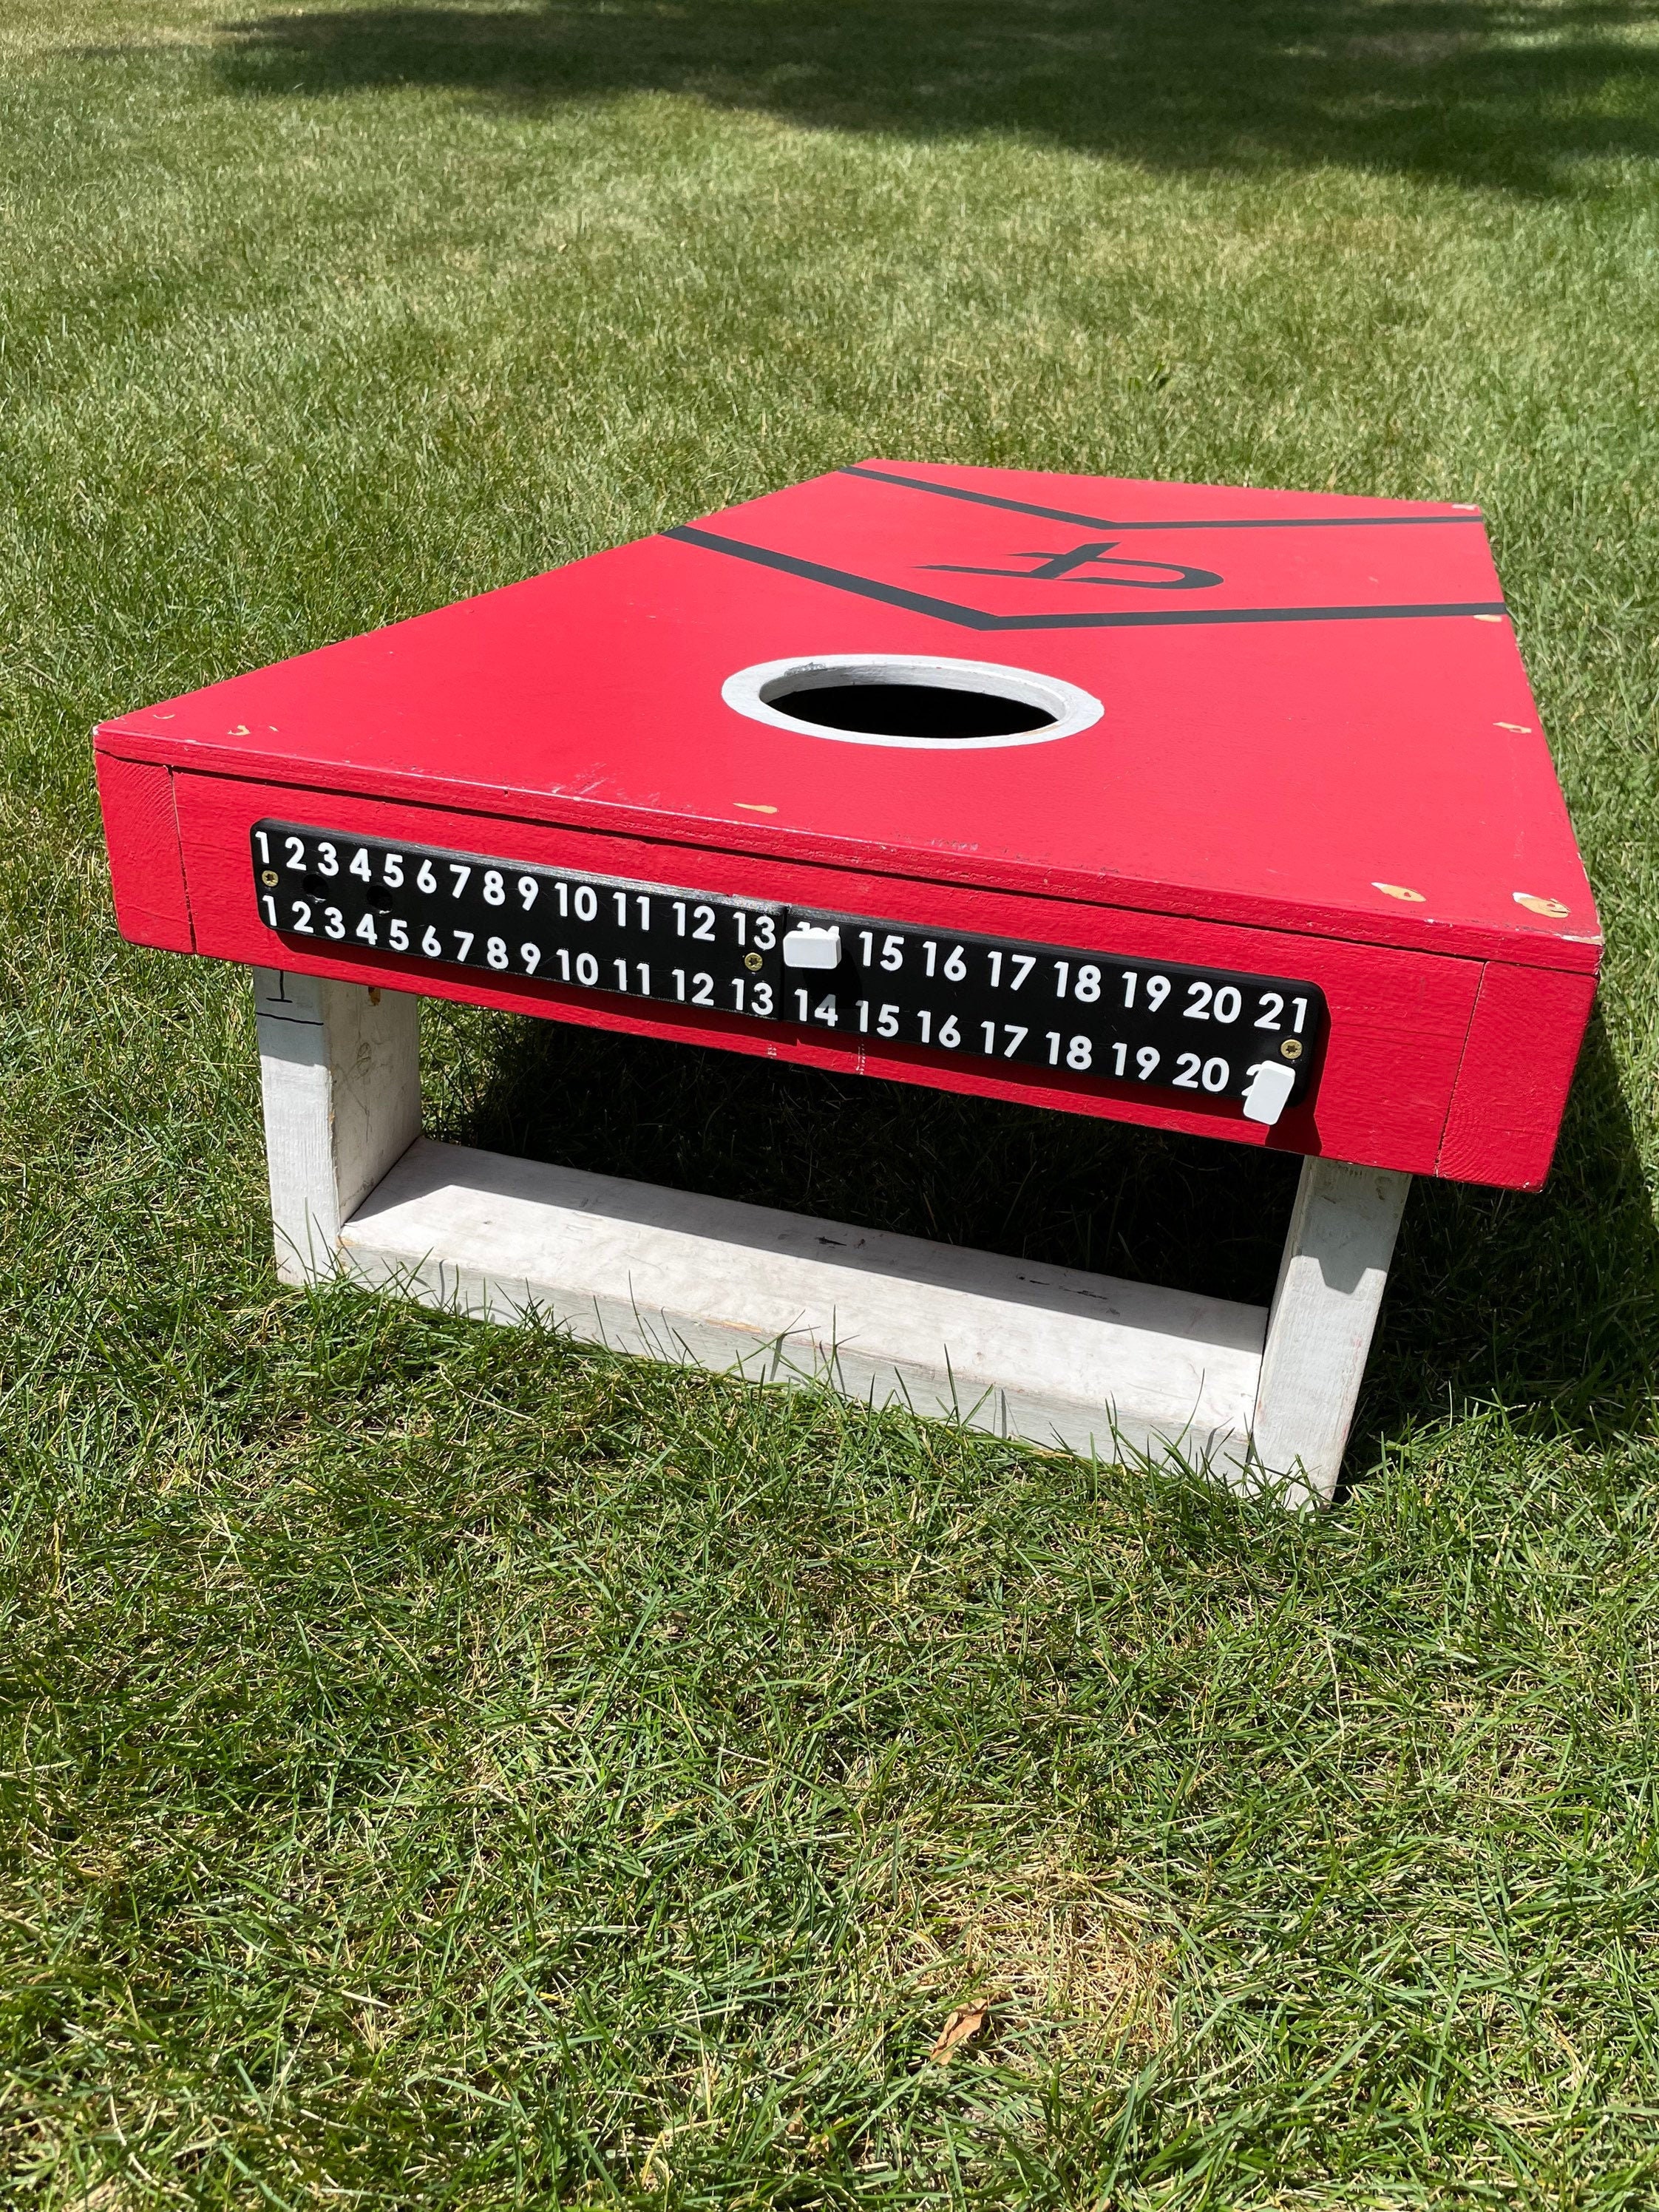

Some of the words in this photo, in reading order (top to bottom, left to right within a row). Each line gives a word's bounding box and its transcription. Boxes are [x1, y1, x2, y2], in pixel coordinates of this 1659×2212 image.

[254, 830, 270, 864] 1
[285, 836, 307, 871] 2
[317, 841, 339, 877] 3
[349, 847, 372, 883] 4
[382, 852, 404, 888] 5
[416, 859, 437, 894] 6
[449, 864, 472, 899] 7
[483, 870, 506, 906] 8
[518, 875, 539, 912] 9
[554, 882, 597, 922] 10
[612, 892, 650, 931] 11
[672, 901, 716, 942] 12
[733, 912, 776, 951] 13
[858, 931, 905, 971] 15
[922, 940, 967, 982] 16
[987, 951, 1037, 991] 17
[1054, 961, 1102, 1002] 18
[1122, 971, 1171, 1013] 19
[1182, 981, 1242, 1024] 20
[1253, 992, 1308, 1034] 21
[262, 895, 277, 926] 1
[291, 900, 314, 934] 2
[324, 906, 346, 939] 3
[356, 913, 378, 946] 4
[388, 918, 410, 951] 5
[421, 925, 442, 957] 6
[453, 930, 475, 963] 7
[486, 936, 509, 969] 8
[520, 942, 541, 975] 9
[556, 949, 599, 985] 10
[613, 959, 650, 995] 11
[671, 968, 714, 1006] 12
[731, 978, 773, 1016] 13
[794, 988, 838, 1027] 14
[855, 1000, 900, 1037] 15
[917, 1010, 961, 1048] 16
[980, 1020, 1028, 1058] 17
[1045, 1031, 1092, 1071] 18
[1112, 1042, 1161, 1081] 19
[1172, 1052, 1229, 1092] 20
